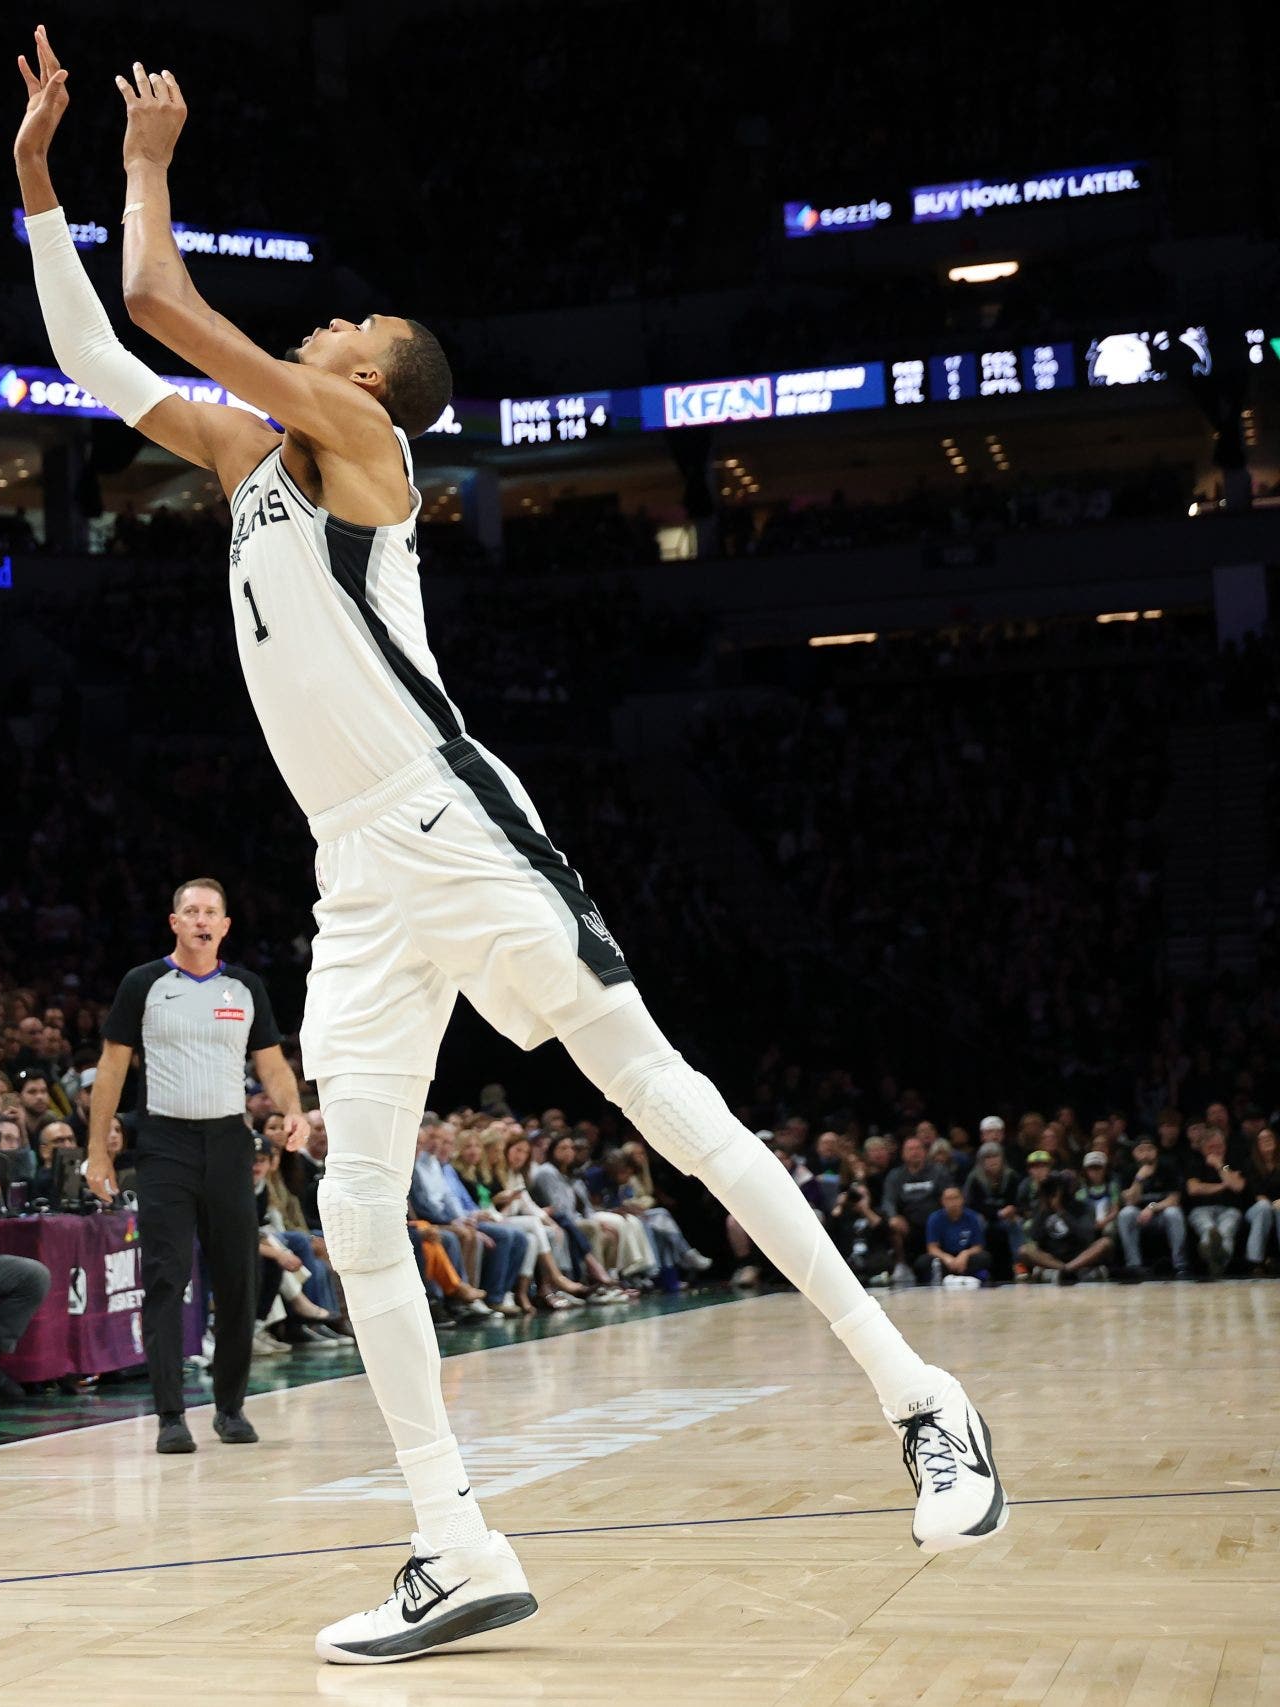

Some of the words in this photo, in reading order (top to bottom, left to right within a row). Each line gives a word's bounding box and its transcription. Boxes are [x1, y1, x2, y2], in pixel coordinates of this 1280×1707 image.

[914, 190, 960, 216] BUY
[961, 183, 1022, 210] NOW.
[1023, 177, 1065, 202] PAY
[1067, 169, 1140, 198] LATER.
[820, 199, 892, 226] sezzle
[219, 233, 253, 256] PAY
[512, 400, 551, 423] NYK
[665, 378, 772, 427] KFAN
[590, 405, 606, 427] 4
[513, 420, 551, 444] PHI
[557, 418, 587, 440] 114
[243, 580, 271, 643] 1
